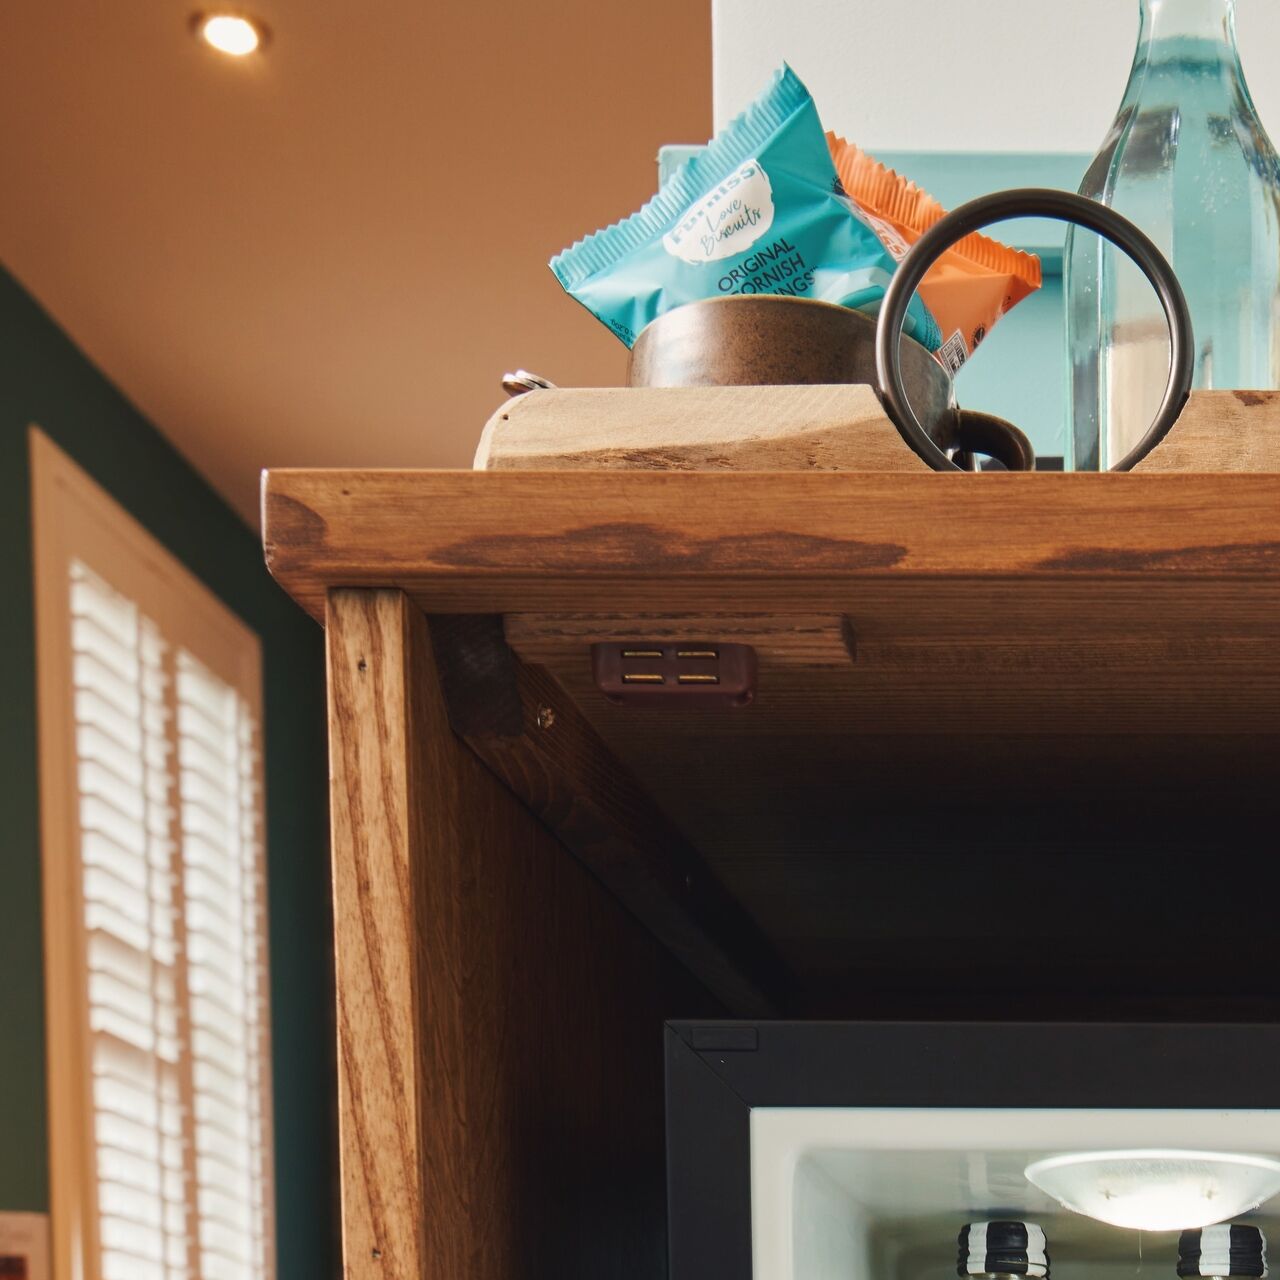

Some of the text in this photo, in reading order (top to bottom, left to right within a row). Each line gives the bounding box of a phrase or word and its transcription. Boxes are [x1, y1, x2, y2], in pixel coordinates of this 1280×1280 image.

[699, 204, 763, 257] Biscuits
[704, 198, 743, 233] Love
[717, 237, 797, 293] ORIGINAL
[730, 252, 806, 295] ORNISH
